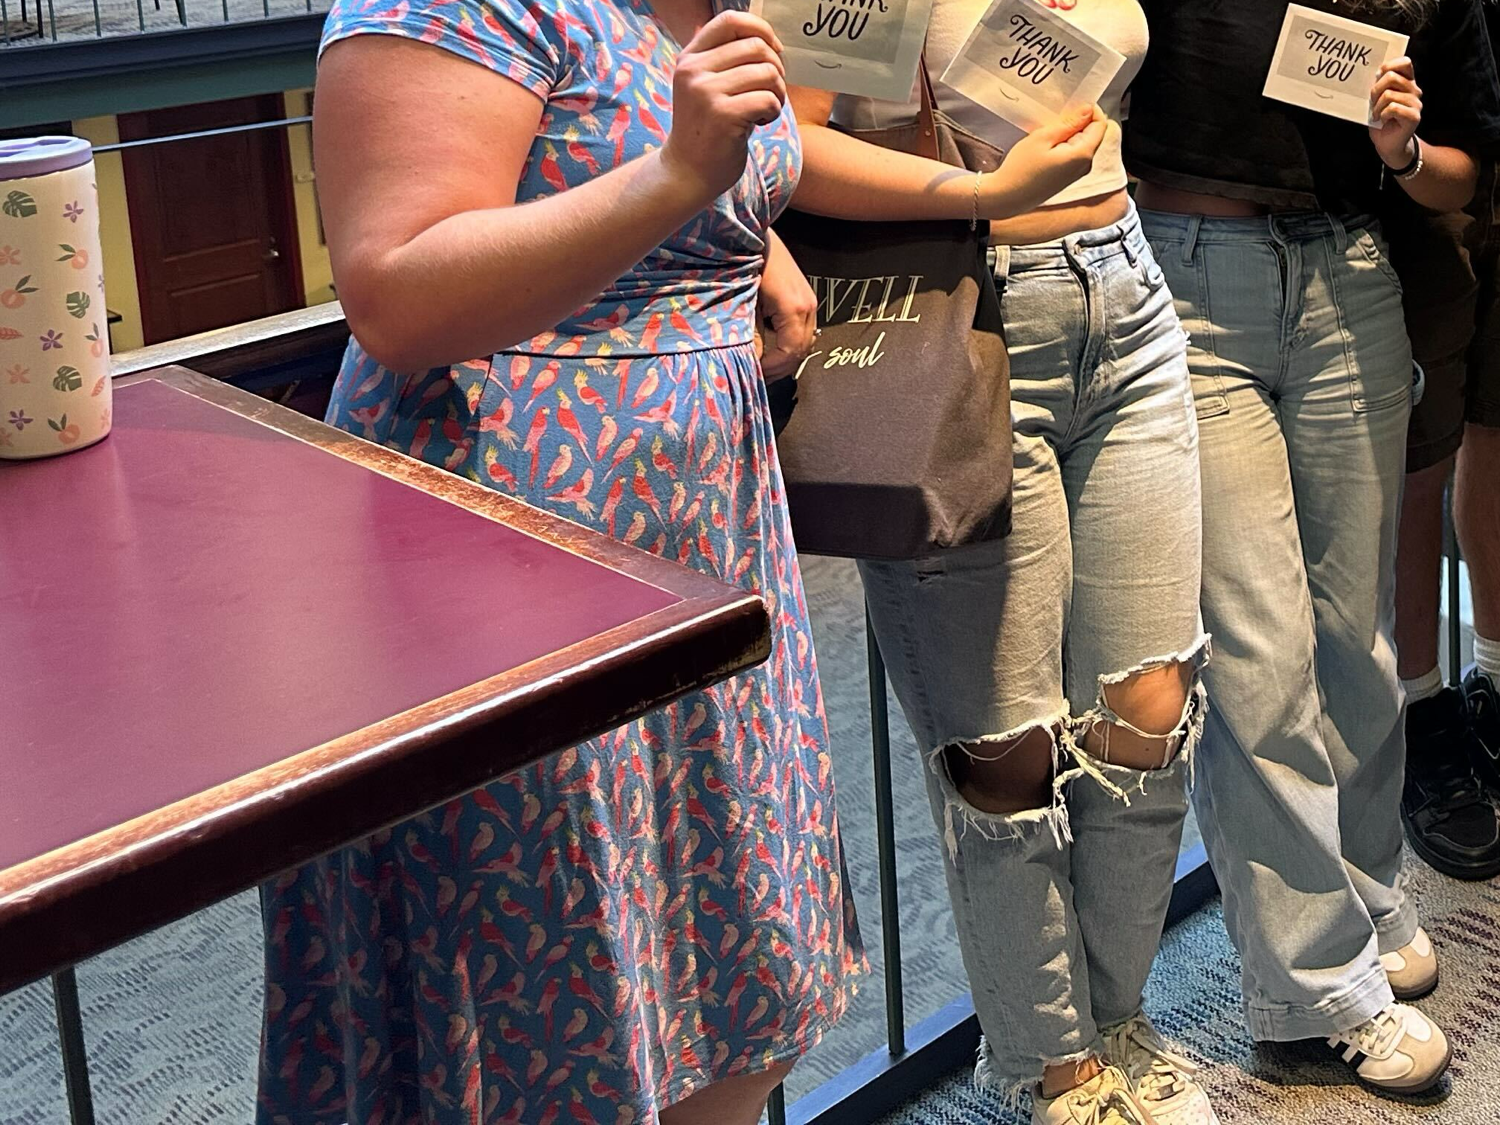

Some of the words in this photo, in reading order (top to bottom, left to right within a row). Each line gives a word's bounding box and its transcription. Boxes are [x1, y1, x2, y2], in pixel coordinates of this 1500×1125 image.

[802, 3, 869, 41] YOU
[1009, 14, 1080, 74] THANK
[1304, 29, 1372, 66] THANK
[999, 46, 1055, 85] YOU
[1308, 55, 1355, 82] YOU
[823, 331, 885, 369] soul
